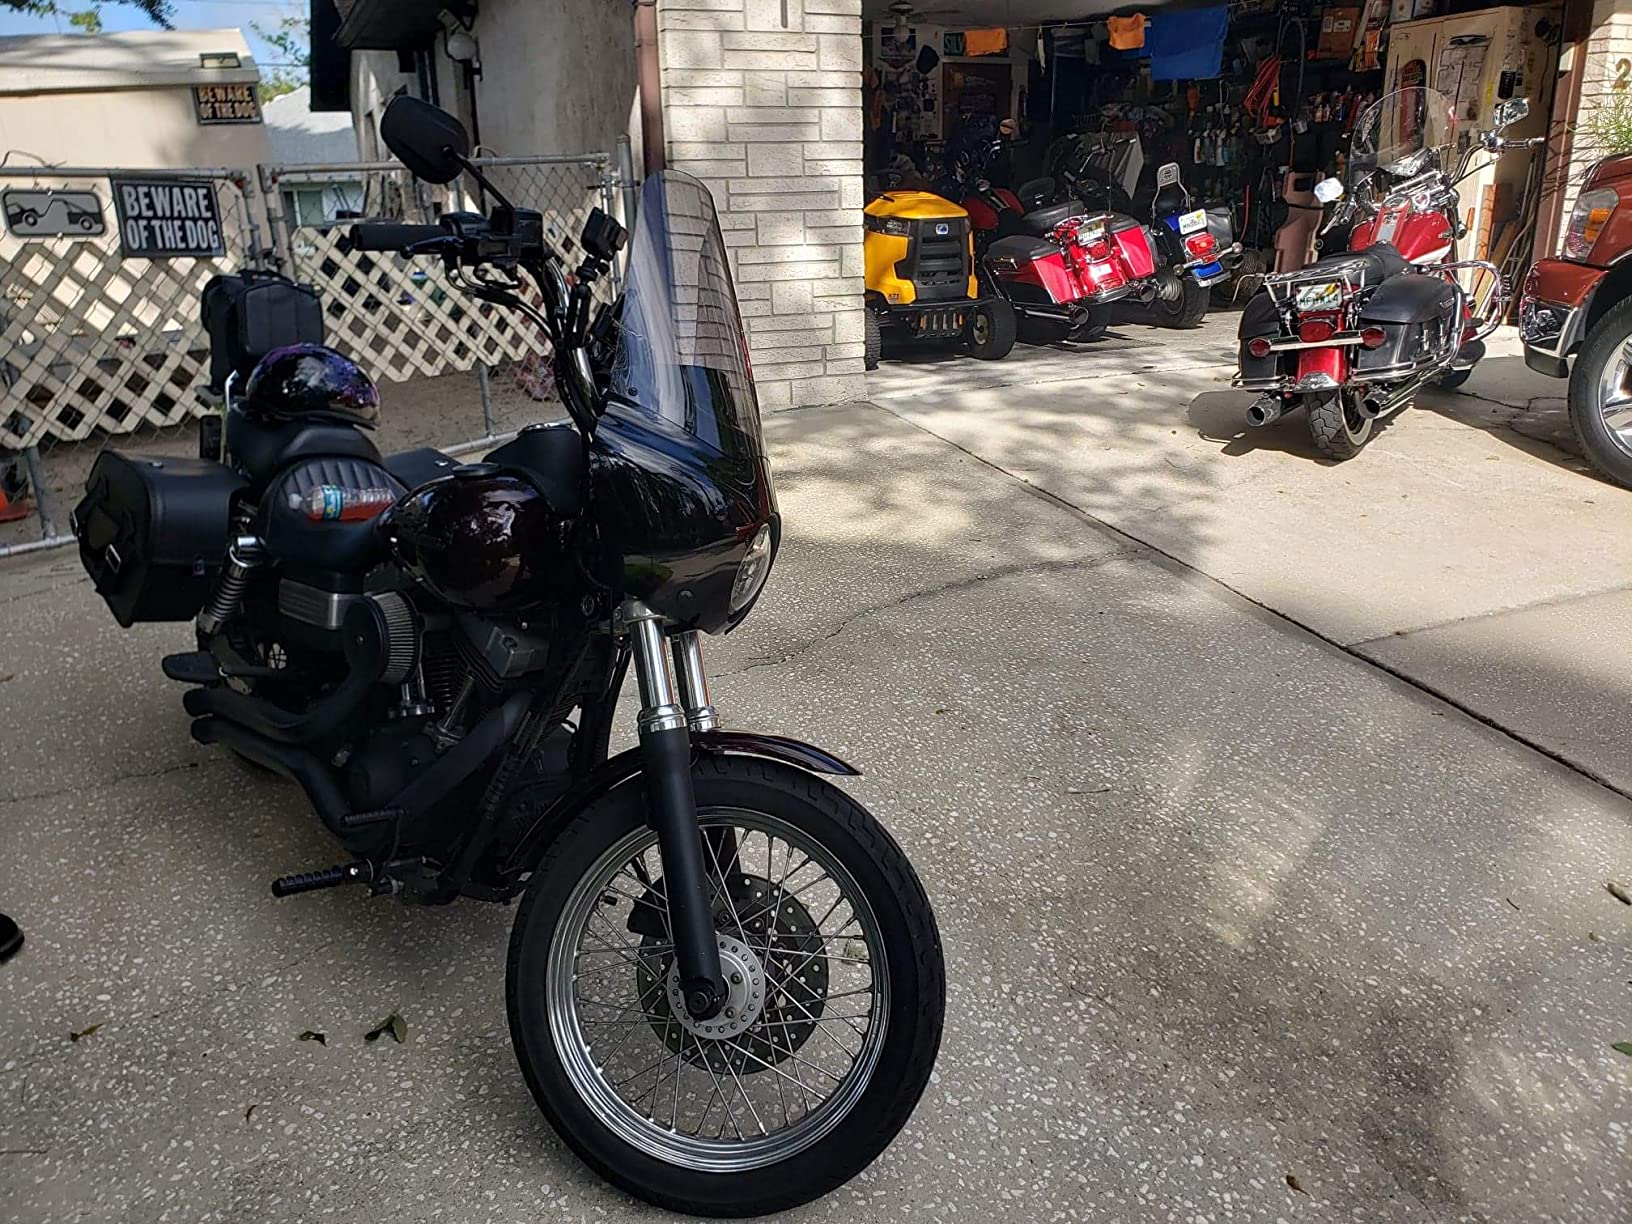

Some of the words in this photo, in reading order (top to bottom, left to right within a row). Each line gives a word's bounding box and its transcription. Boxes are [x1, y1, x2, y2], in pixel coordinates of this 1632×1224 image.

[198, 86, 252, 102] BEWARE
[200, 102, 213, 119] OF
[214, 102, 234, 118] THE
[234, 101, 257, 118] DOG
[122, 185, 212, 218] BEWARE
[126, 219, 149, 250] OF
[150, 219, 186, 250] THE
[184, 220, 219, 250] DOG
